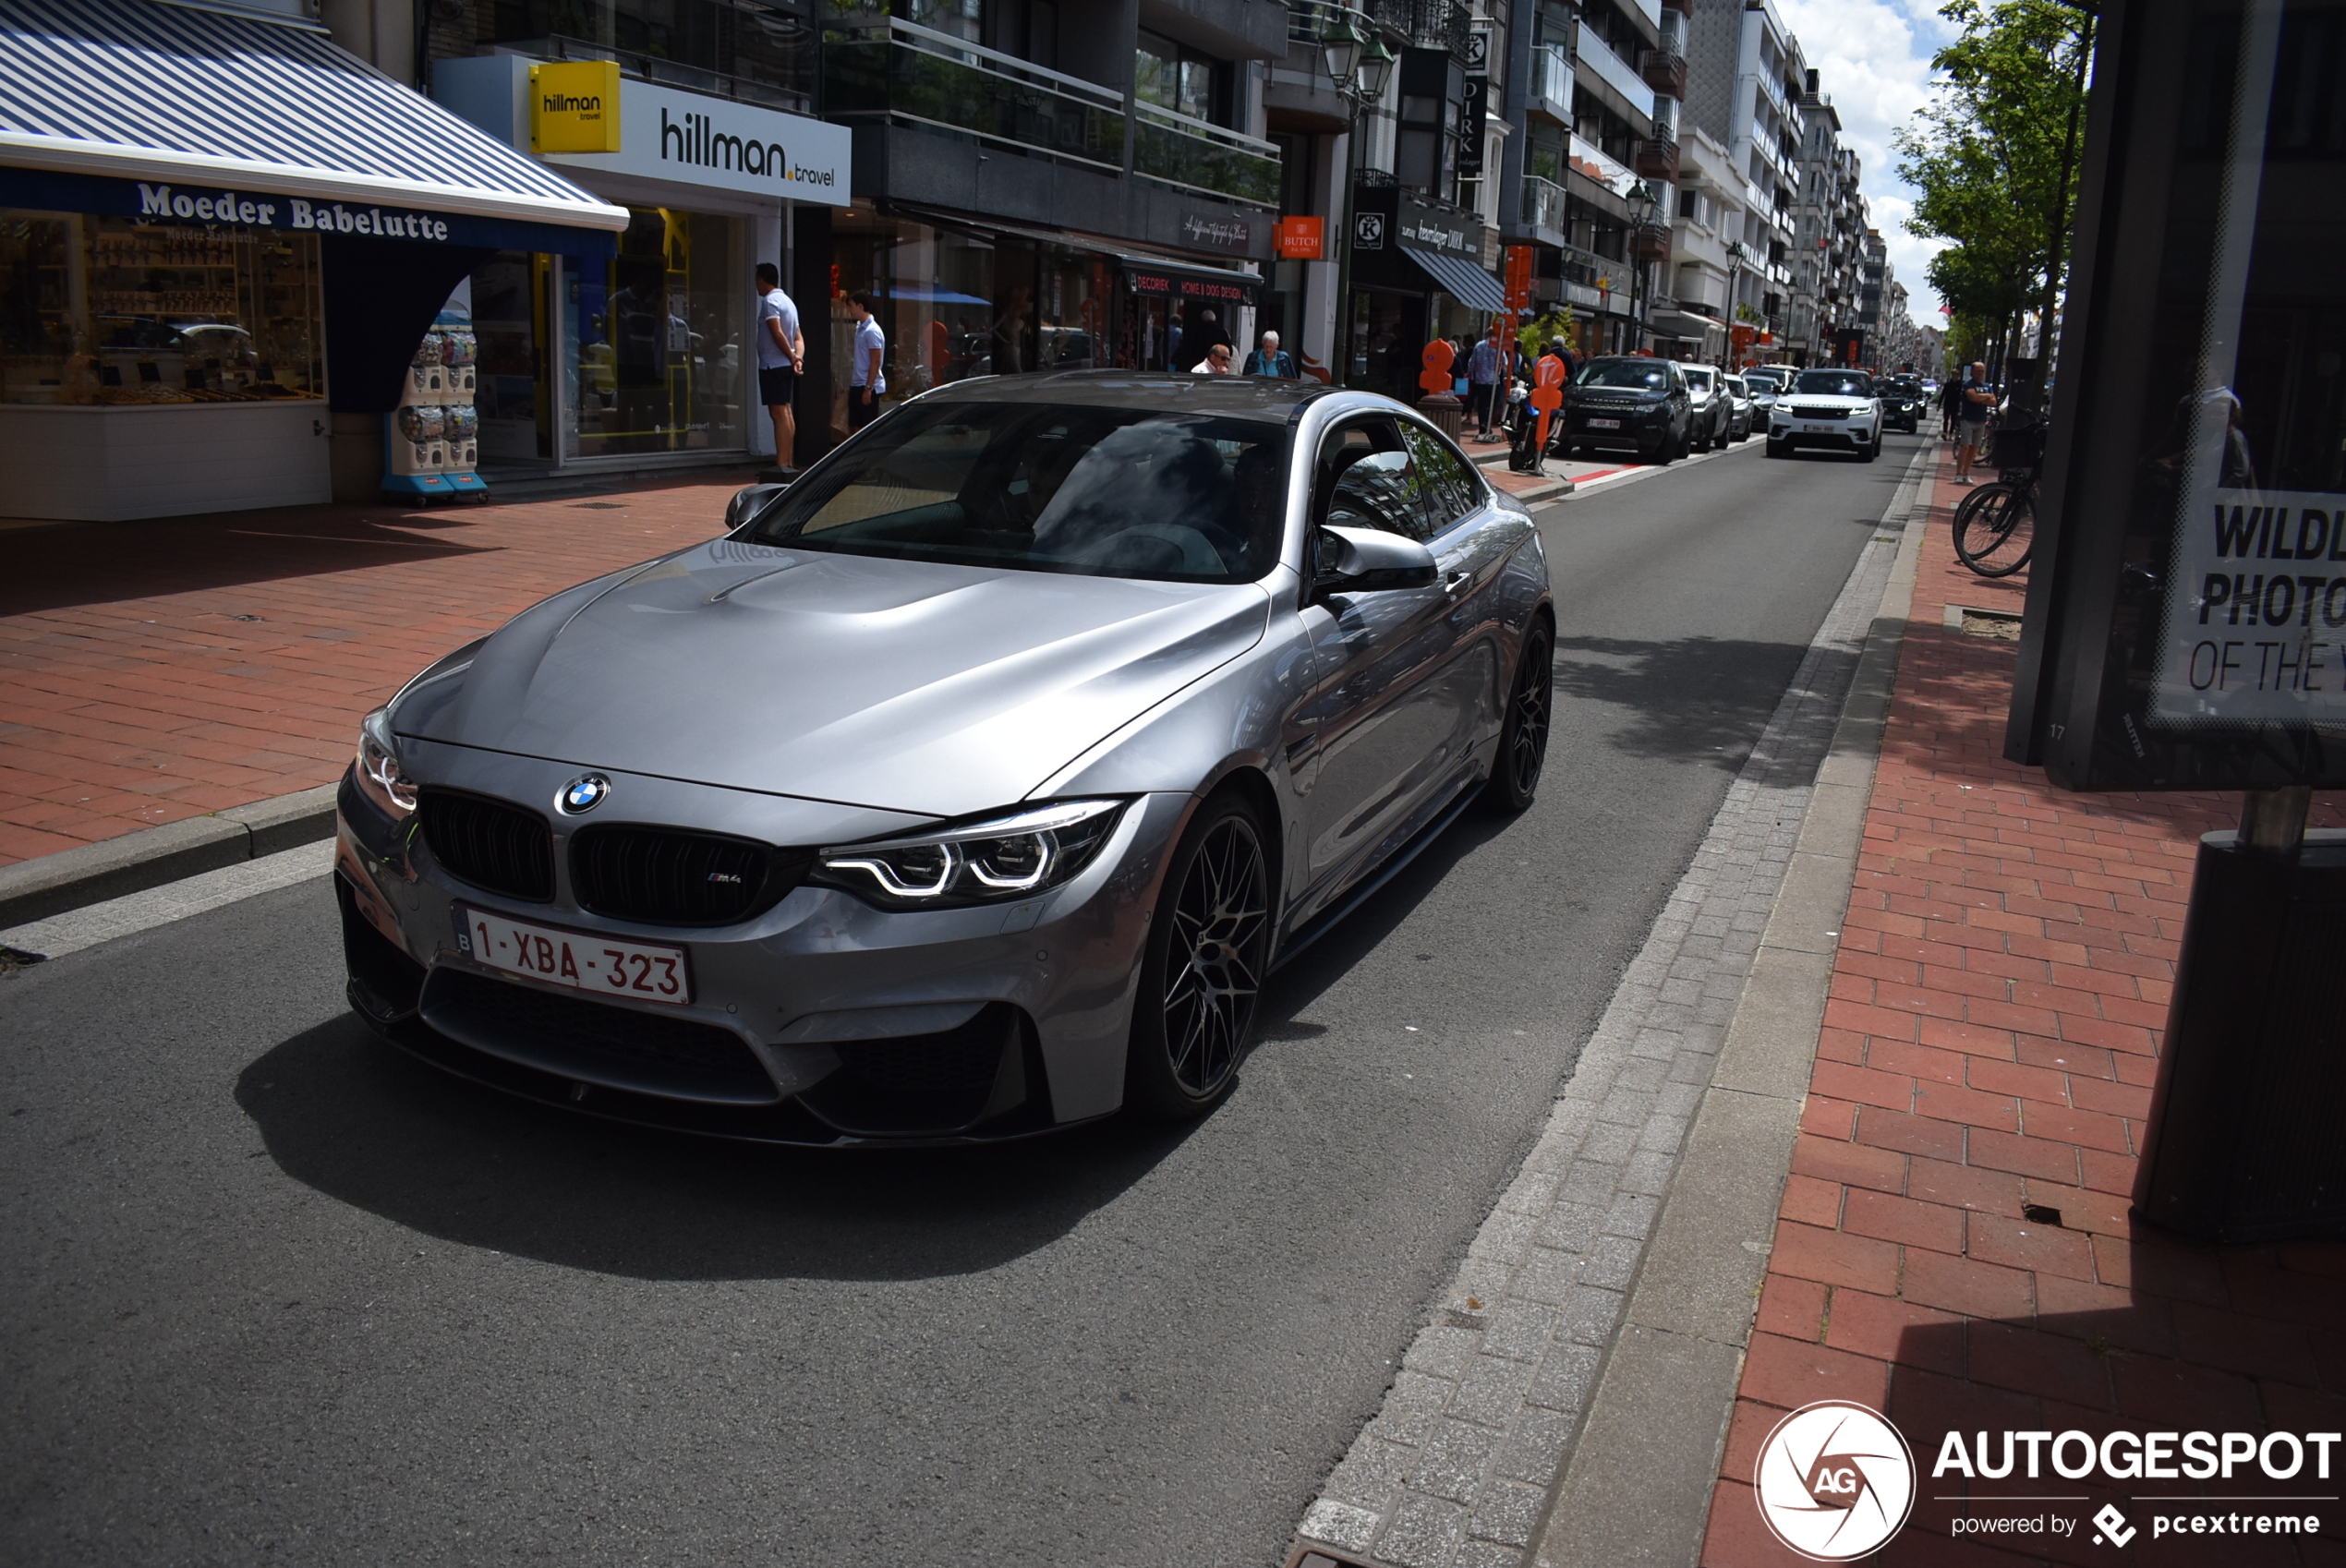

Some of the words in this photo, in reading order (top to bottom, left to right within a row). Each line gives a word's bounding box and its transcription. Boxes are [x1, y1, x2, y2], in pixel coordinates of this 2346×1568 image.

[543, 93, 600, 113] hillman
[1460, 81, 1477, 152] DIRK
[139, 183, 275, 226] Moeder
[291, 199, 449, 241] Babelutte
[166, 227, 205, 240] Moeder
[208, 230, 260, 245] Babelutte
[1361, 223, 1377, 236] K
[1285, 236, 1319, 247] BUTCH
[1447, 229, 1465, 251] DIRK
[1137, 275, 1170, 292] DECORIEK
[1180, 280, 1201, 296] HOME
[1205, 283, 1221, 296] DOG
[1220, 285, 1243, 300] DESIGN
[2189, 640, 2244, 692] OF
[2255, 641, 2325, 692] THE
[2050, 722, 2065, 742] 17
[716, 872, 743, 885] M4
[457, 933, 471, 952] B
